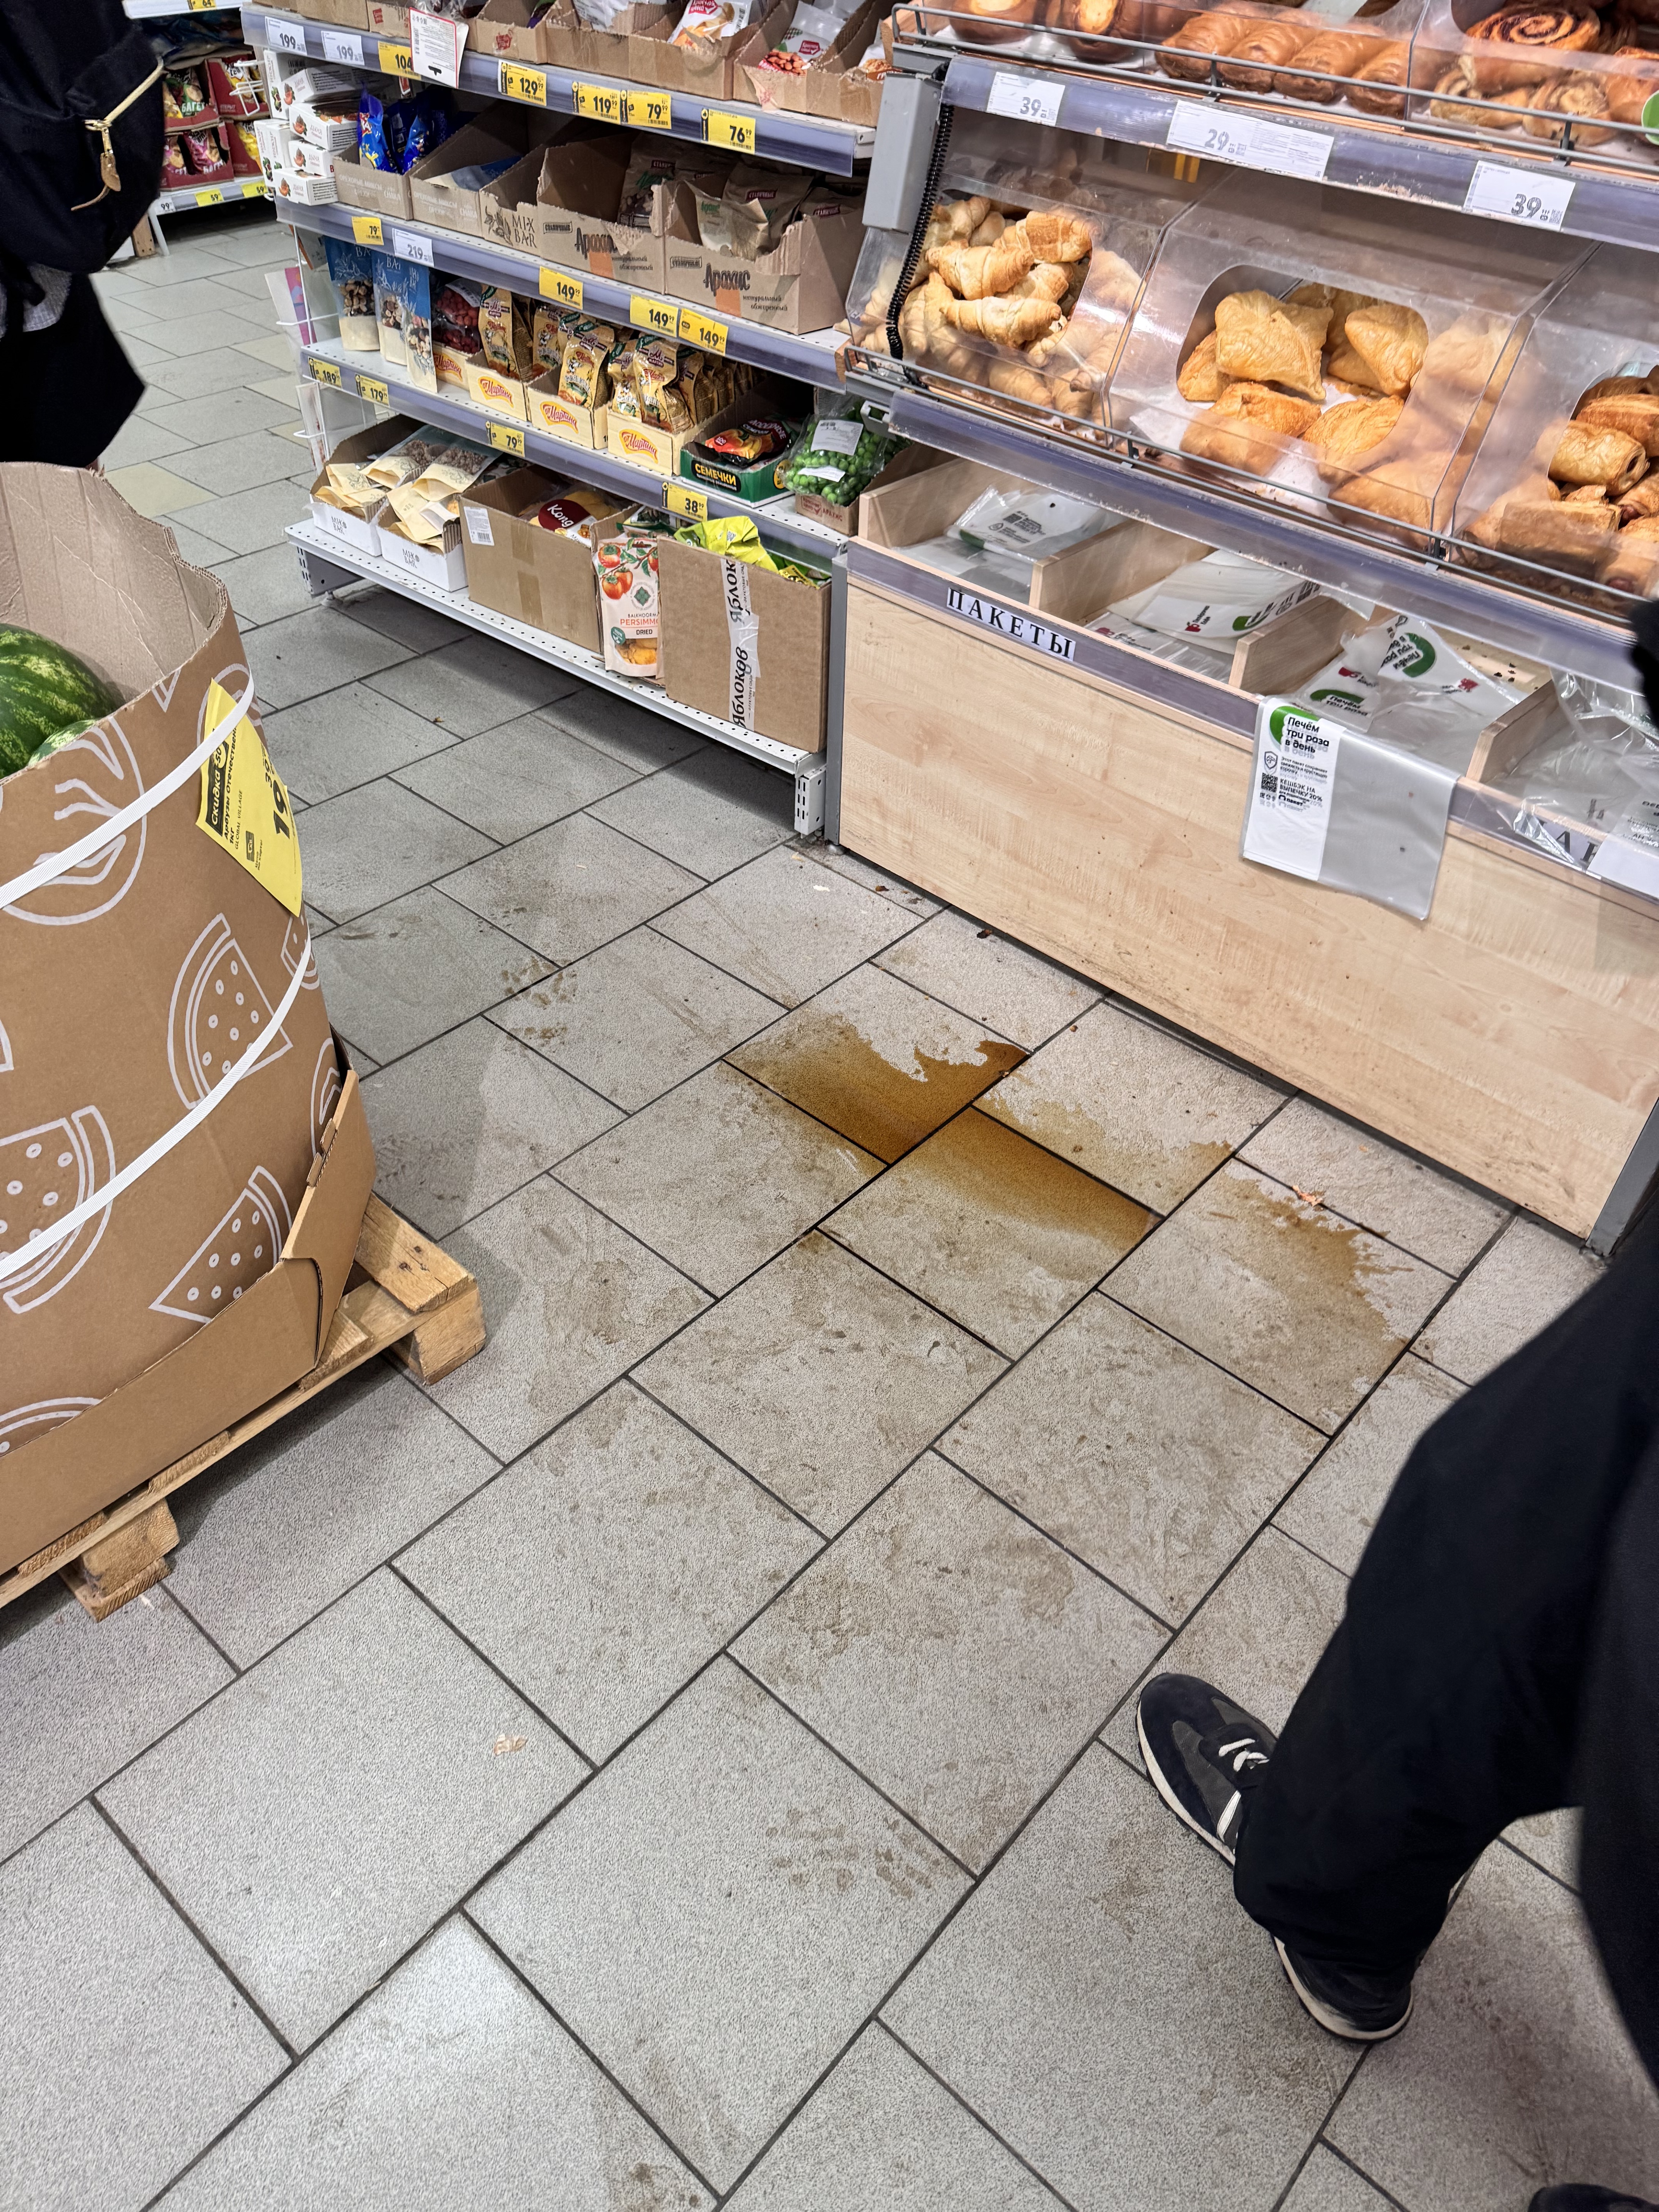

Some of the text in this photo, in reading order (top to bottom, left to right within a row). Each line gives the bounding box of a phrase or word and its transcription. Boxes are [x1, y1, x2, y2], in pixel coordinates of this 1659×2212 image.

[280, 33, 296, 49] 199
[337, 45, 353, 60] 199
[395, 54, 412, 71] 104
[520, 77, 538, 95] 129
[593, 96, 611, 113] 119
[647, 103, 661, 119] 79
[1020, 96, 1041, 116] 39
[730, 125, 745, 143] 76
[1204, 129, 1230, 150] 29
[1511, 194, 1542, 218] 39
[369, 226, 377, 235] 79
[407, 244, 423, 259] 219
[703, 263, 750, 297] Арахис
[557, 282, 574, 299] 149
[649, 309, 668, 326] 149
[699, 328, 718, 346] 149
[323, 370, 336, 383] 189
[370, 388, 383, 401] 179
[485, 381, 512, 401] Мартина
[548, 406, 576, 426] Мартина
[507, 434, 517, 449] 79
[627, 433, 656, 457] Мартина
[695, 464, 737, 486] СЕМЕЧКИ
[685, 498, 698, 513] 38
[548, 504, 574, 527] Kong
[822, 508, 843, 521] АРАХИС
[948, 588, 1073, 659] ПАКЕТЫ
[1288, 716, 1320, 733] Печём
[1287, 730, 1329, 747] три раза
[1293, 740, 1316, 753] день
[265, 758, 272, 788] 39
[1280, 778, 1305, 790] КЕШБЭК
[211, 770, 221, 826] Скидка
[1279, 785, 1322, 802] ВЫПЕЧКУ 20%
[273, 780, 290, 840] 19
